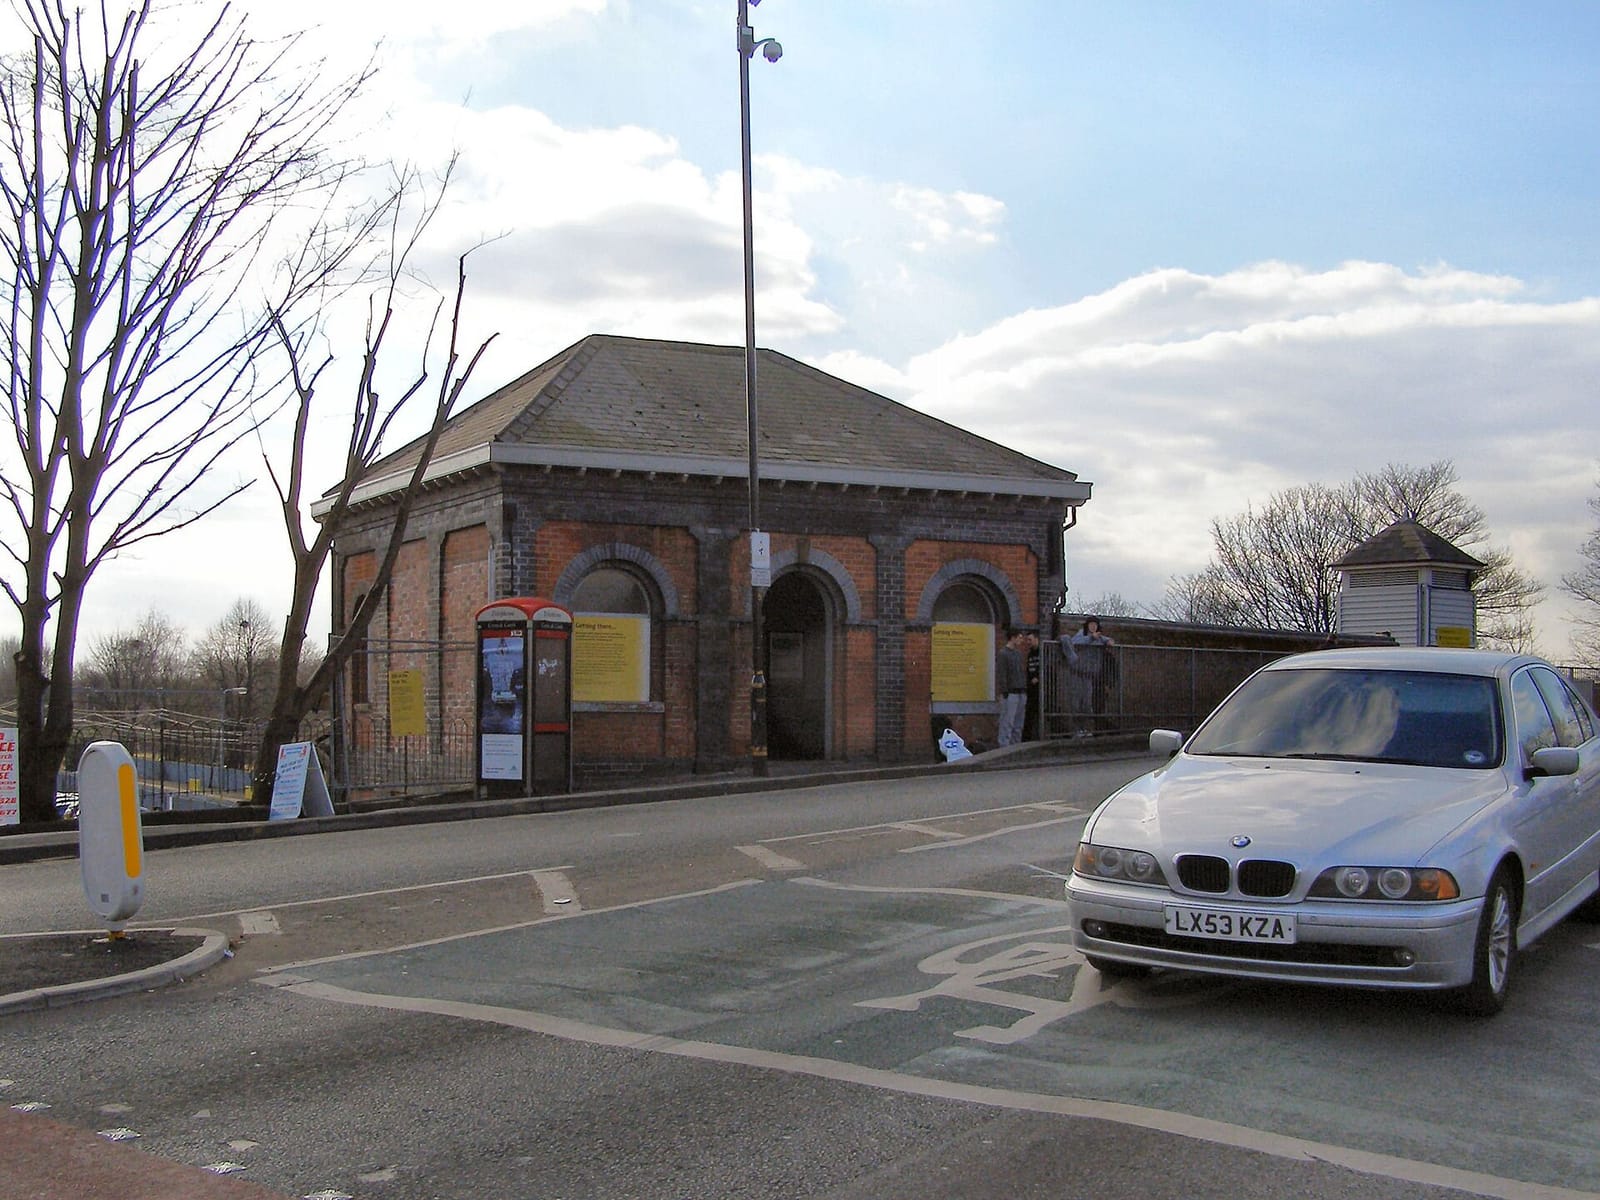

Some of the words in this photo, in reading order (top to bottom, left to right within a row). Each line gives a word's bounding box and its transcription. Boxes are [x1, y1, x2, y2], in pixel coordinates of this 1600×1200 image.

[0, 763, 13, 771] CK
[1175, 911, 1233, 935] LX53
[1239, 916, 1285, 939] KZA
